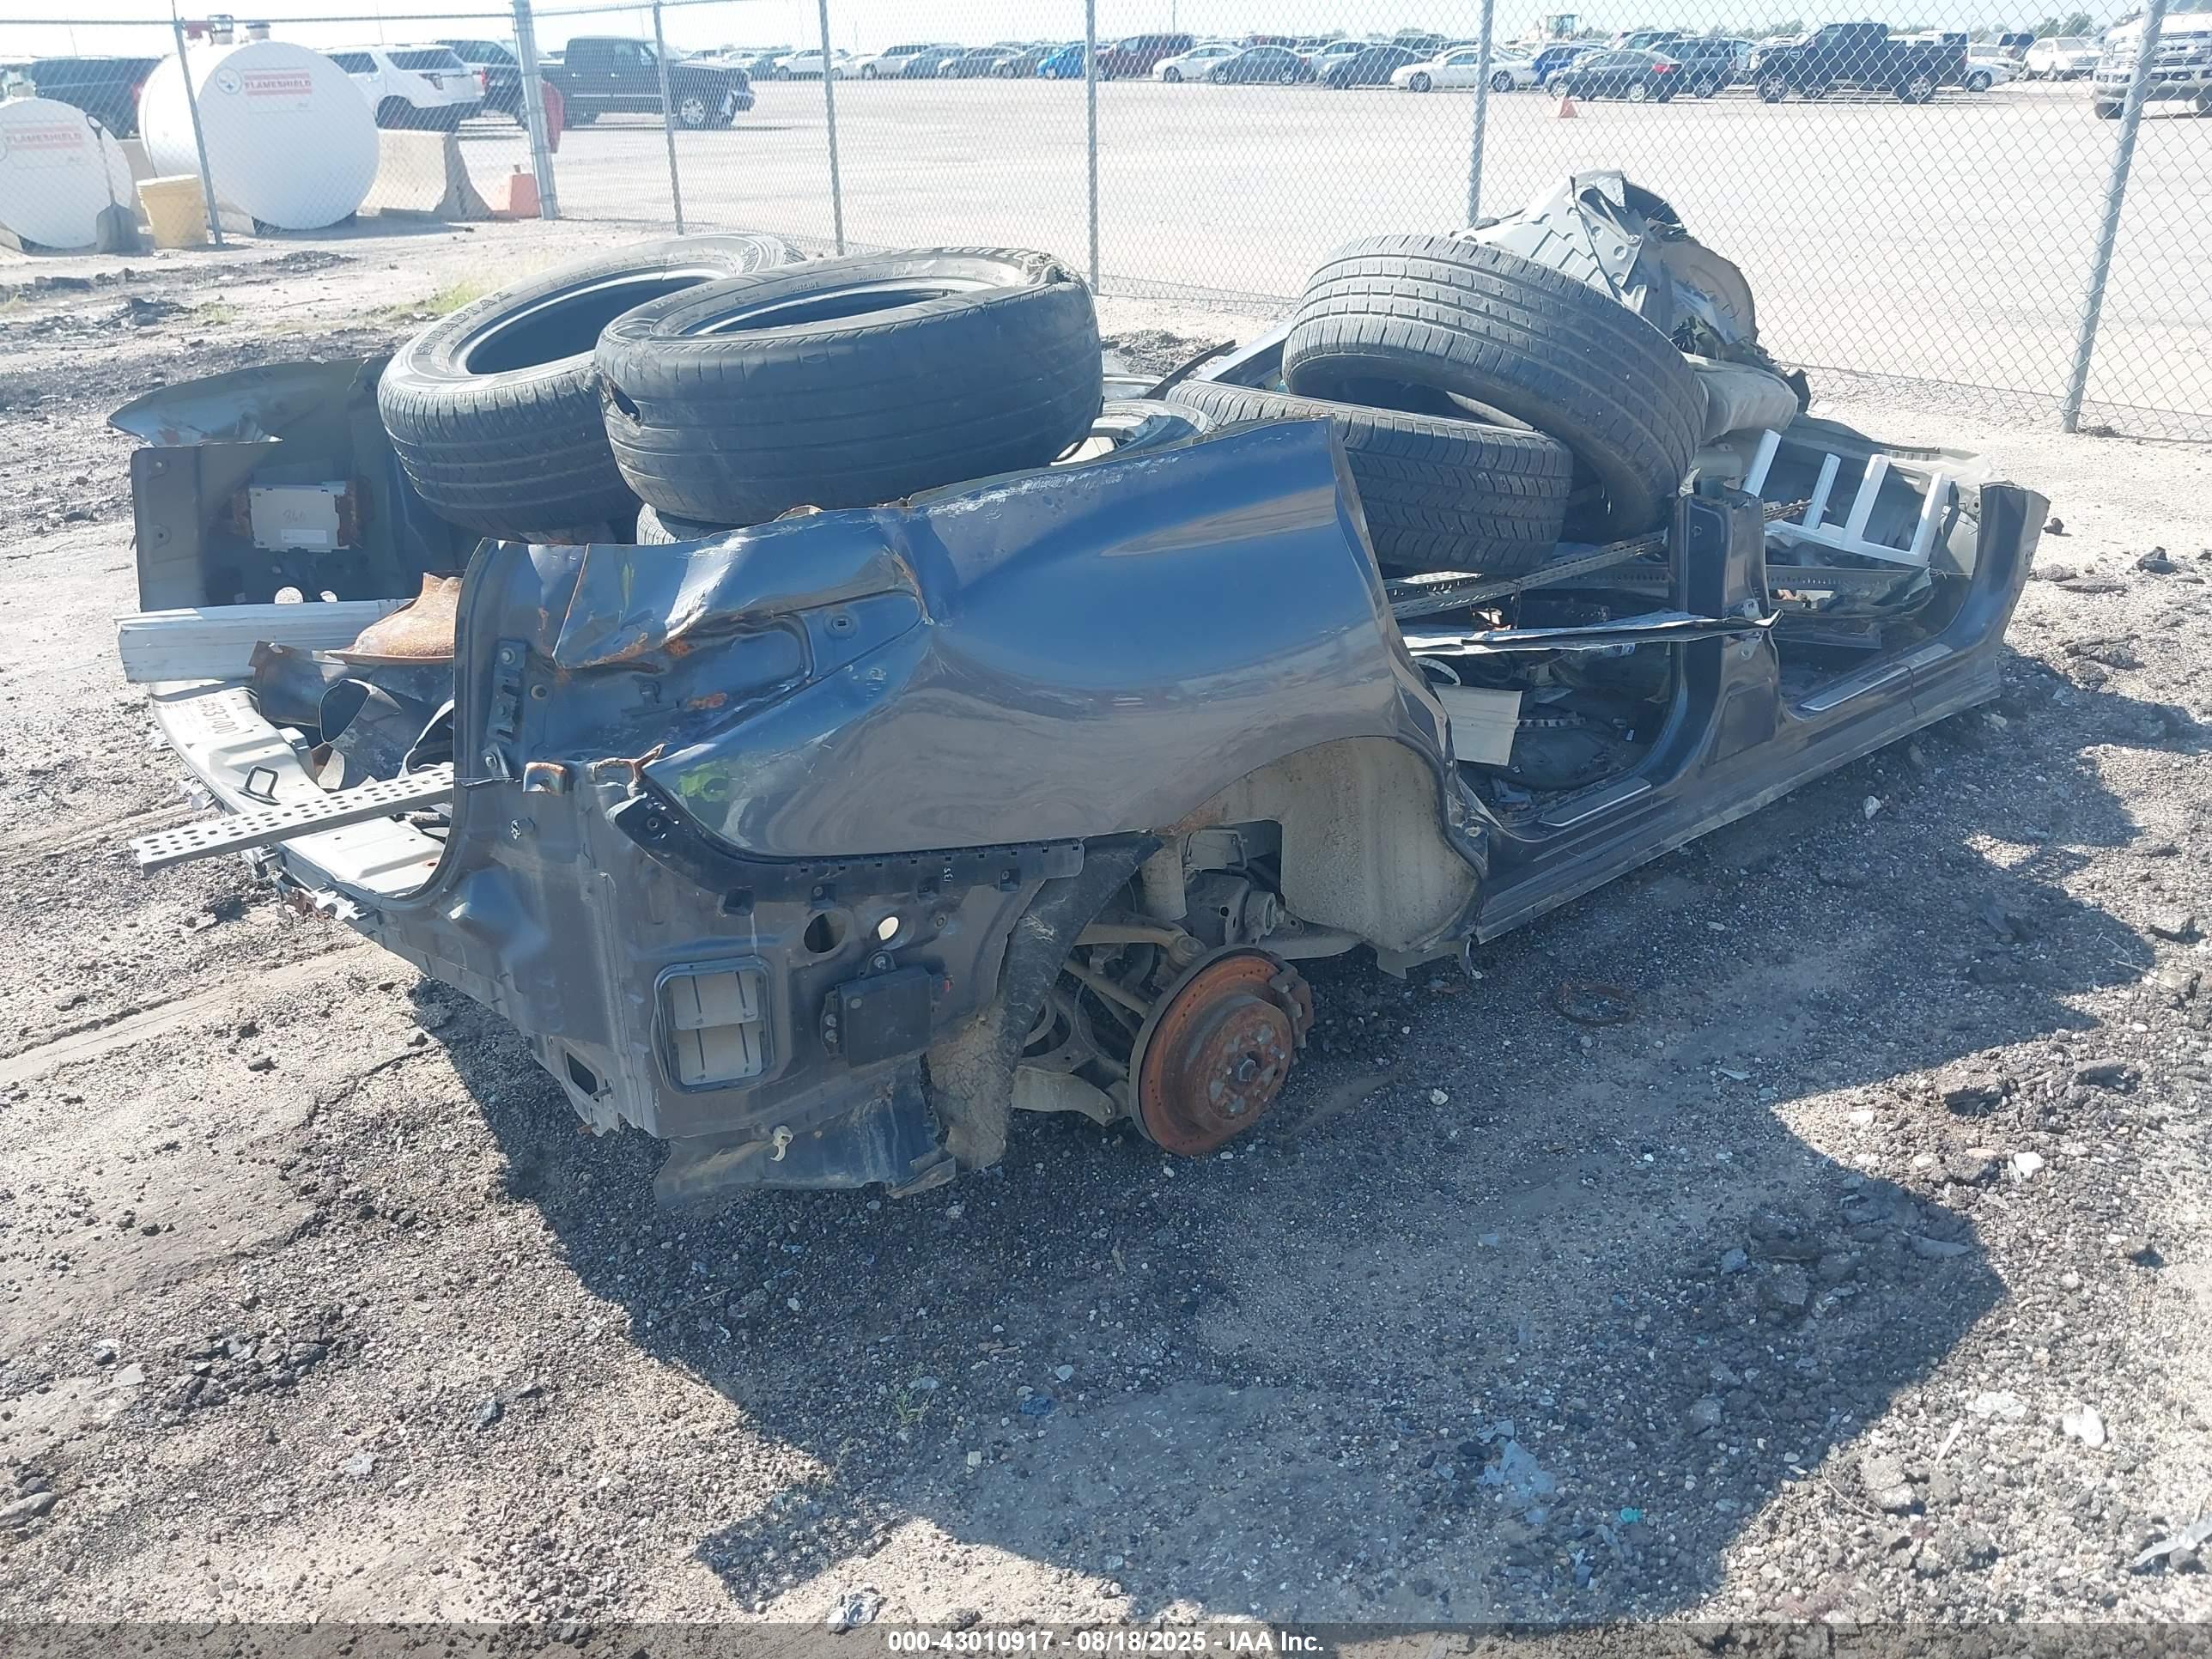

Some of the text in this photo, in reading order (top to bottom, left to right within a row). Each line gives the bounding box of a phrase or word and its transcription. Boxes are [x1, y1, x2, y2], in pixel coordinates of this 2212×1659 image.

[245, 80, 311, 89] FLAMESHIELD
[6, 132, 82, 144] FLAMESHIELD
[427, 291, 514, 341] RADIAL
